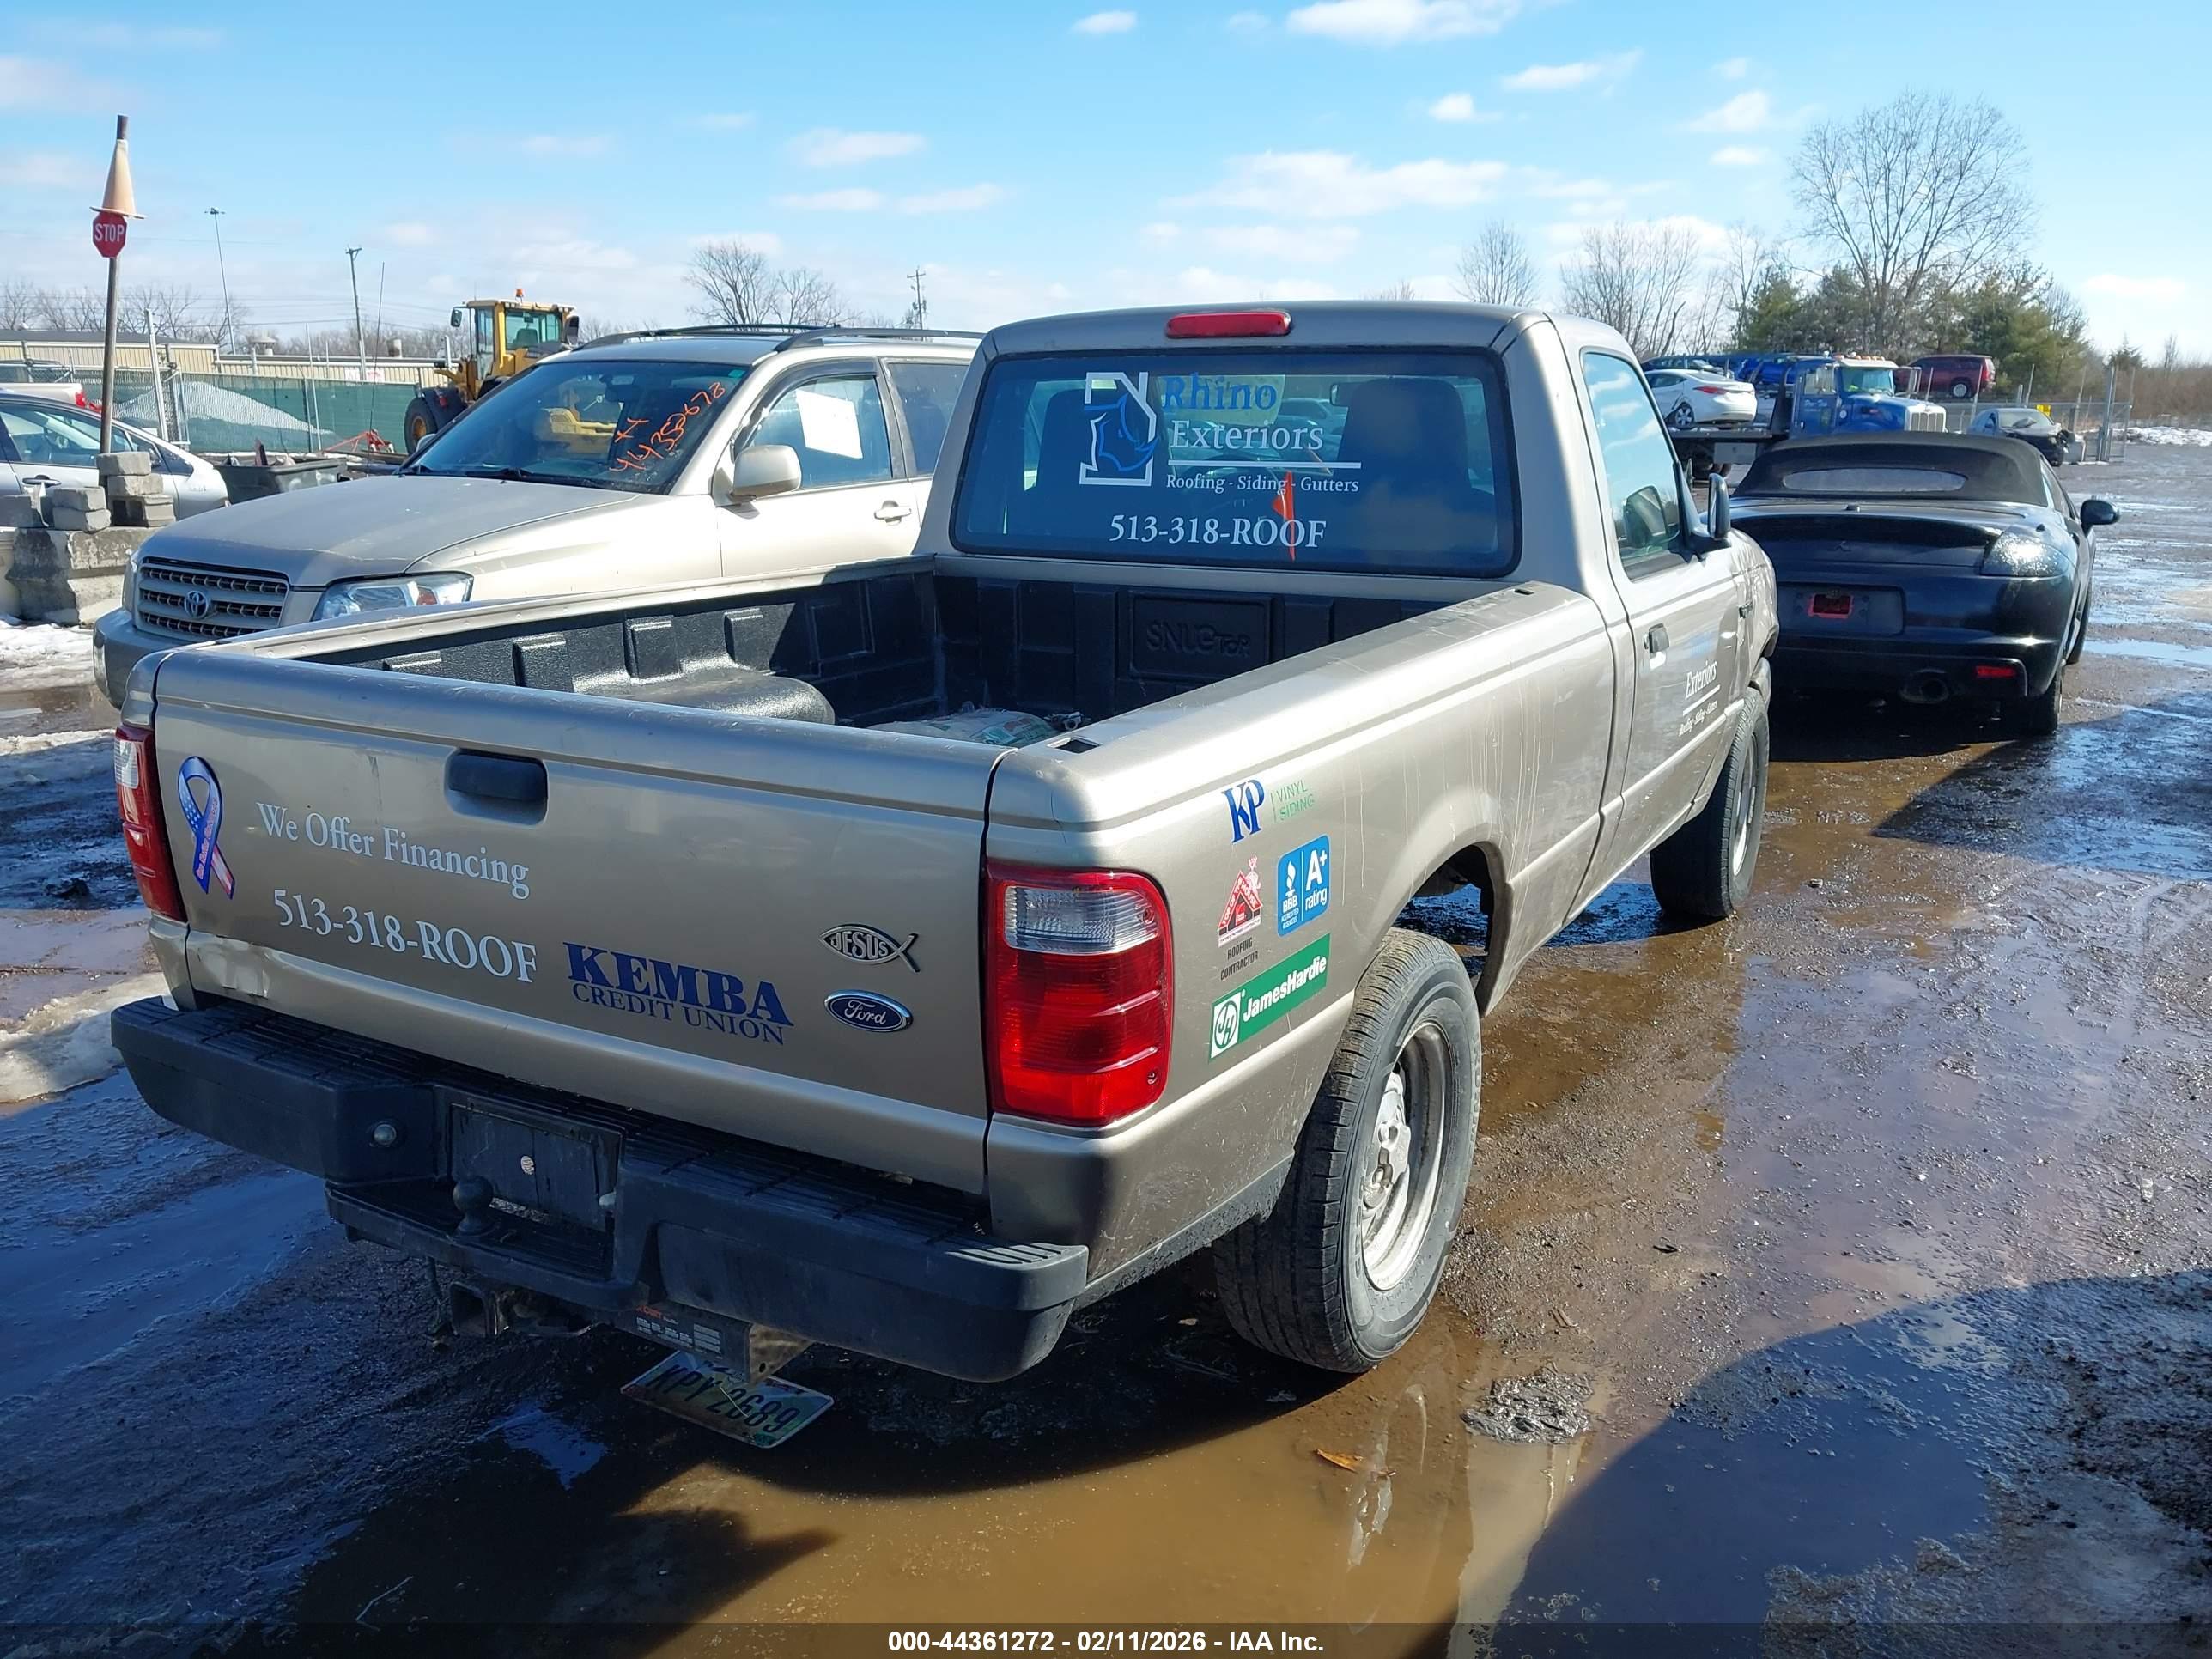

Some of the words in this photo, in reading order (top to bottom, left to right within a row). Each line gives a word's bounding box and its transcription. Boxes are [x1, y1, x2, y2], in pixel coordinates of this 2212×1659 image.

[94, 223, 125, 242] STOP
[1162, 371, 1278, 410] Rhino
[1170, 419, 1324, 451] Exteriors
[1166, 474, 1225, 494] Roofing
[1237, 475, 1286, 495] Siding
[1300, 477, 1359, 492] Gutters
[1109, 514, 1327, 548] 513-318-ROOF
[1685, 659, 1717, 700] Exteriors
[1275, 780, 1308, 803] VINYL
[1279, 793, 1316, 821] SIDING
[1220, 779, 1265, 844] KP
[256, 802, 299, 842] We
[305, 812, 374, 857] Offer
[383, 827, 531, 900] Financing
[1305, 849, 1328, 891] A+
[1282, 895, 1298, 914] BBB
[1304, 887, 1328, 911] rating
[273, 889, 537, 983] 513-318-ROOF
[830, 930, 890, 960] JESUS
[1227, 937, 1254, 961] ROOFING
[1220, 950, 1259, 981] CONTRACTOR
[563, 941, 795, 1027] KEMBA
[1243, 955, 1328, 1023] JamesHardie
[572, 982, 674, 1023] CREDIT
[683, 1006, 785, 1046] UNION
[844, 999, 888, 1026] Ford
[706, 1387, 801, 1433] 2689
